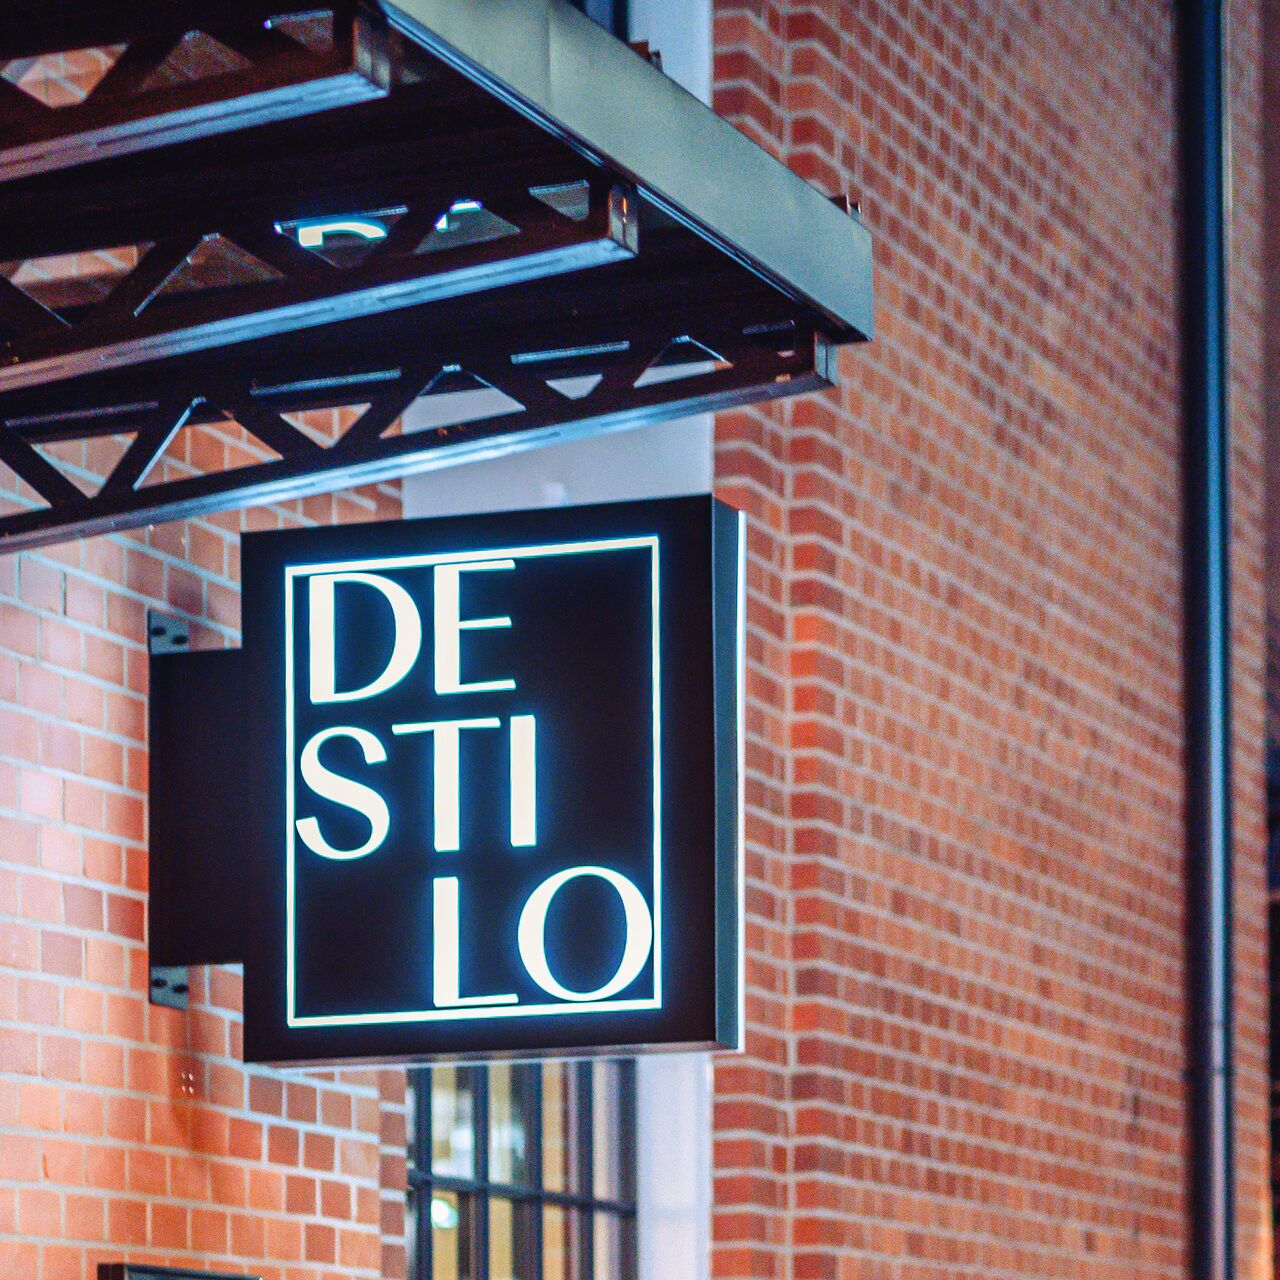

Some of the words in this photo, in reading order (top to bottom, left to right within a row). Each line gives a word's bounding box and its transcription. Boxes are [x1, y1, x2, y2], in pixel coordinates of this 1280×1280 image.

[309, 560, 516, 705] DE
[295, 715, 537, 860] STI
[433, 866, 653, 1008] LO
